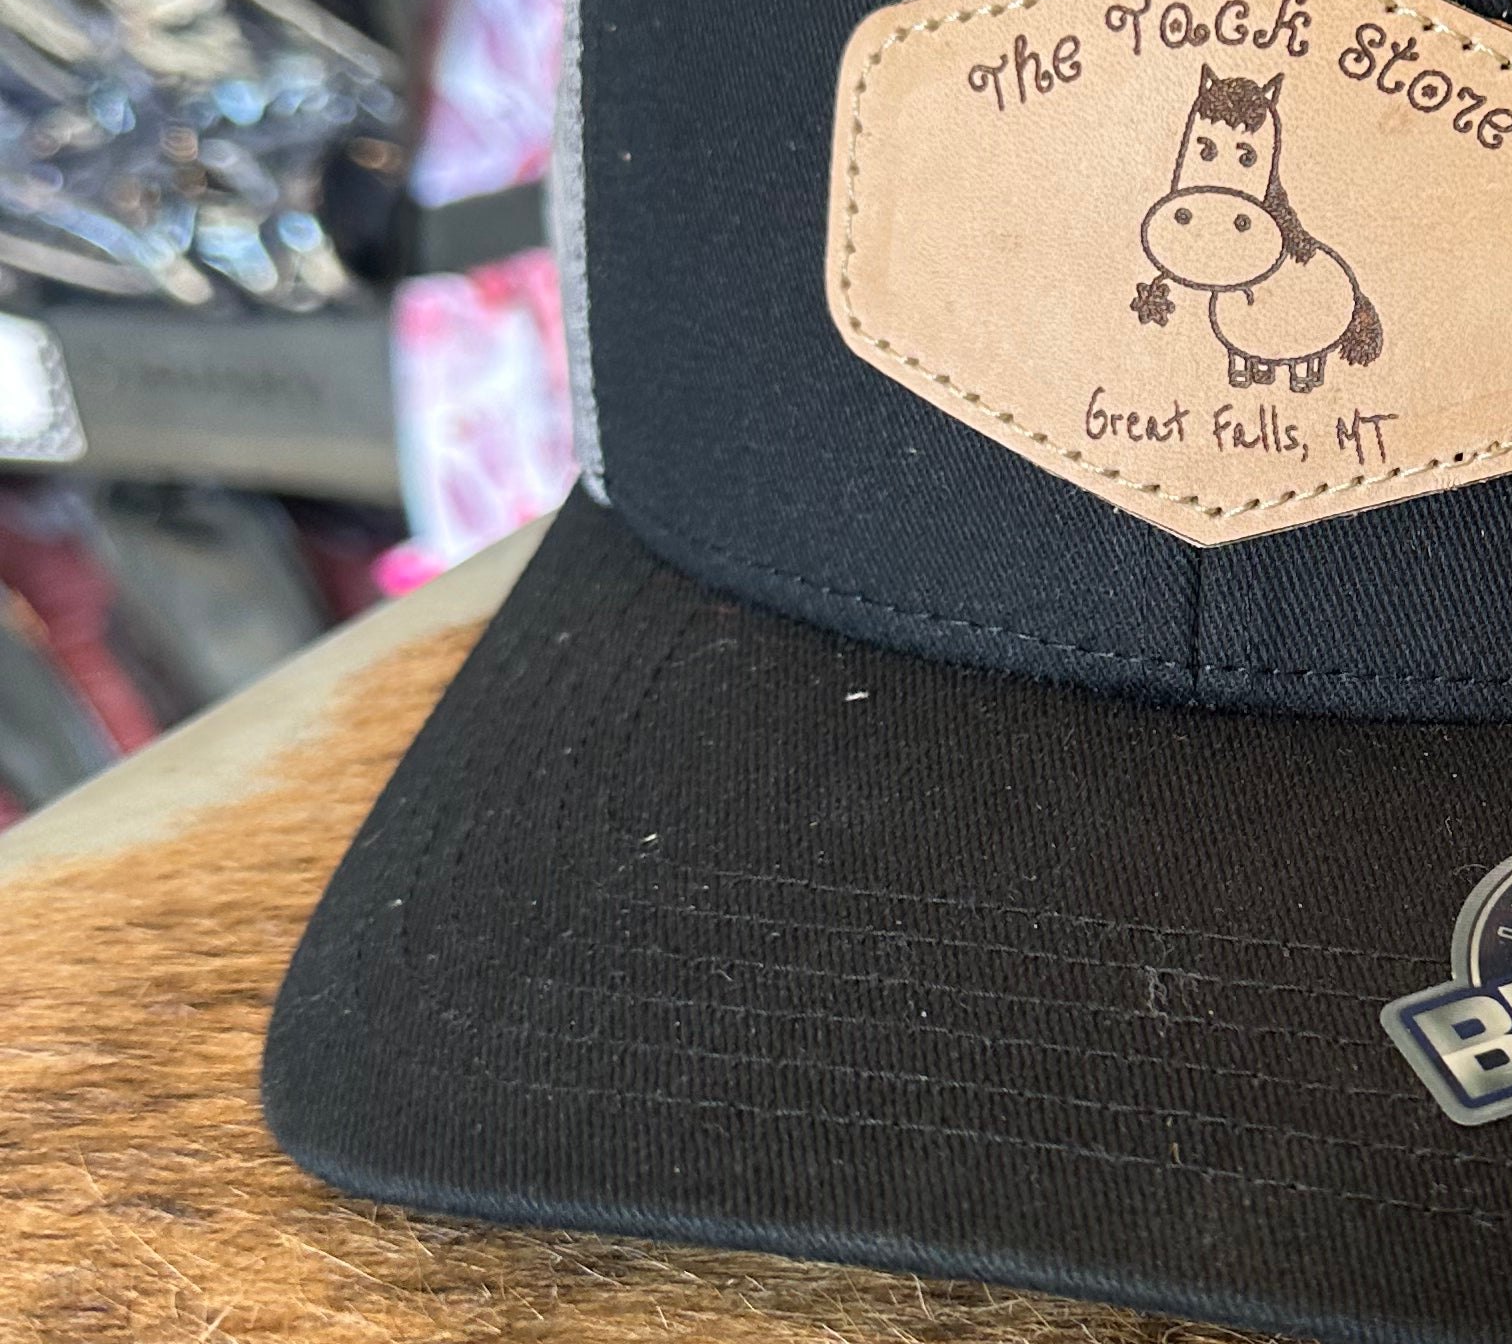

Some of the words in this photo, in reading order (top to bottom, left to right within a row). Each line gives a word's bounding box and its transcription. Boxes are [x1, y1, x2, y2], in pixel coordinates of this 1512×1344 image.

[968, 34, 1082, 111] The
[1086, 386, 1190, 441] Great
[1213, 404, 1309, 462] Falls,
[1336, 408, 1399, 465] MT
